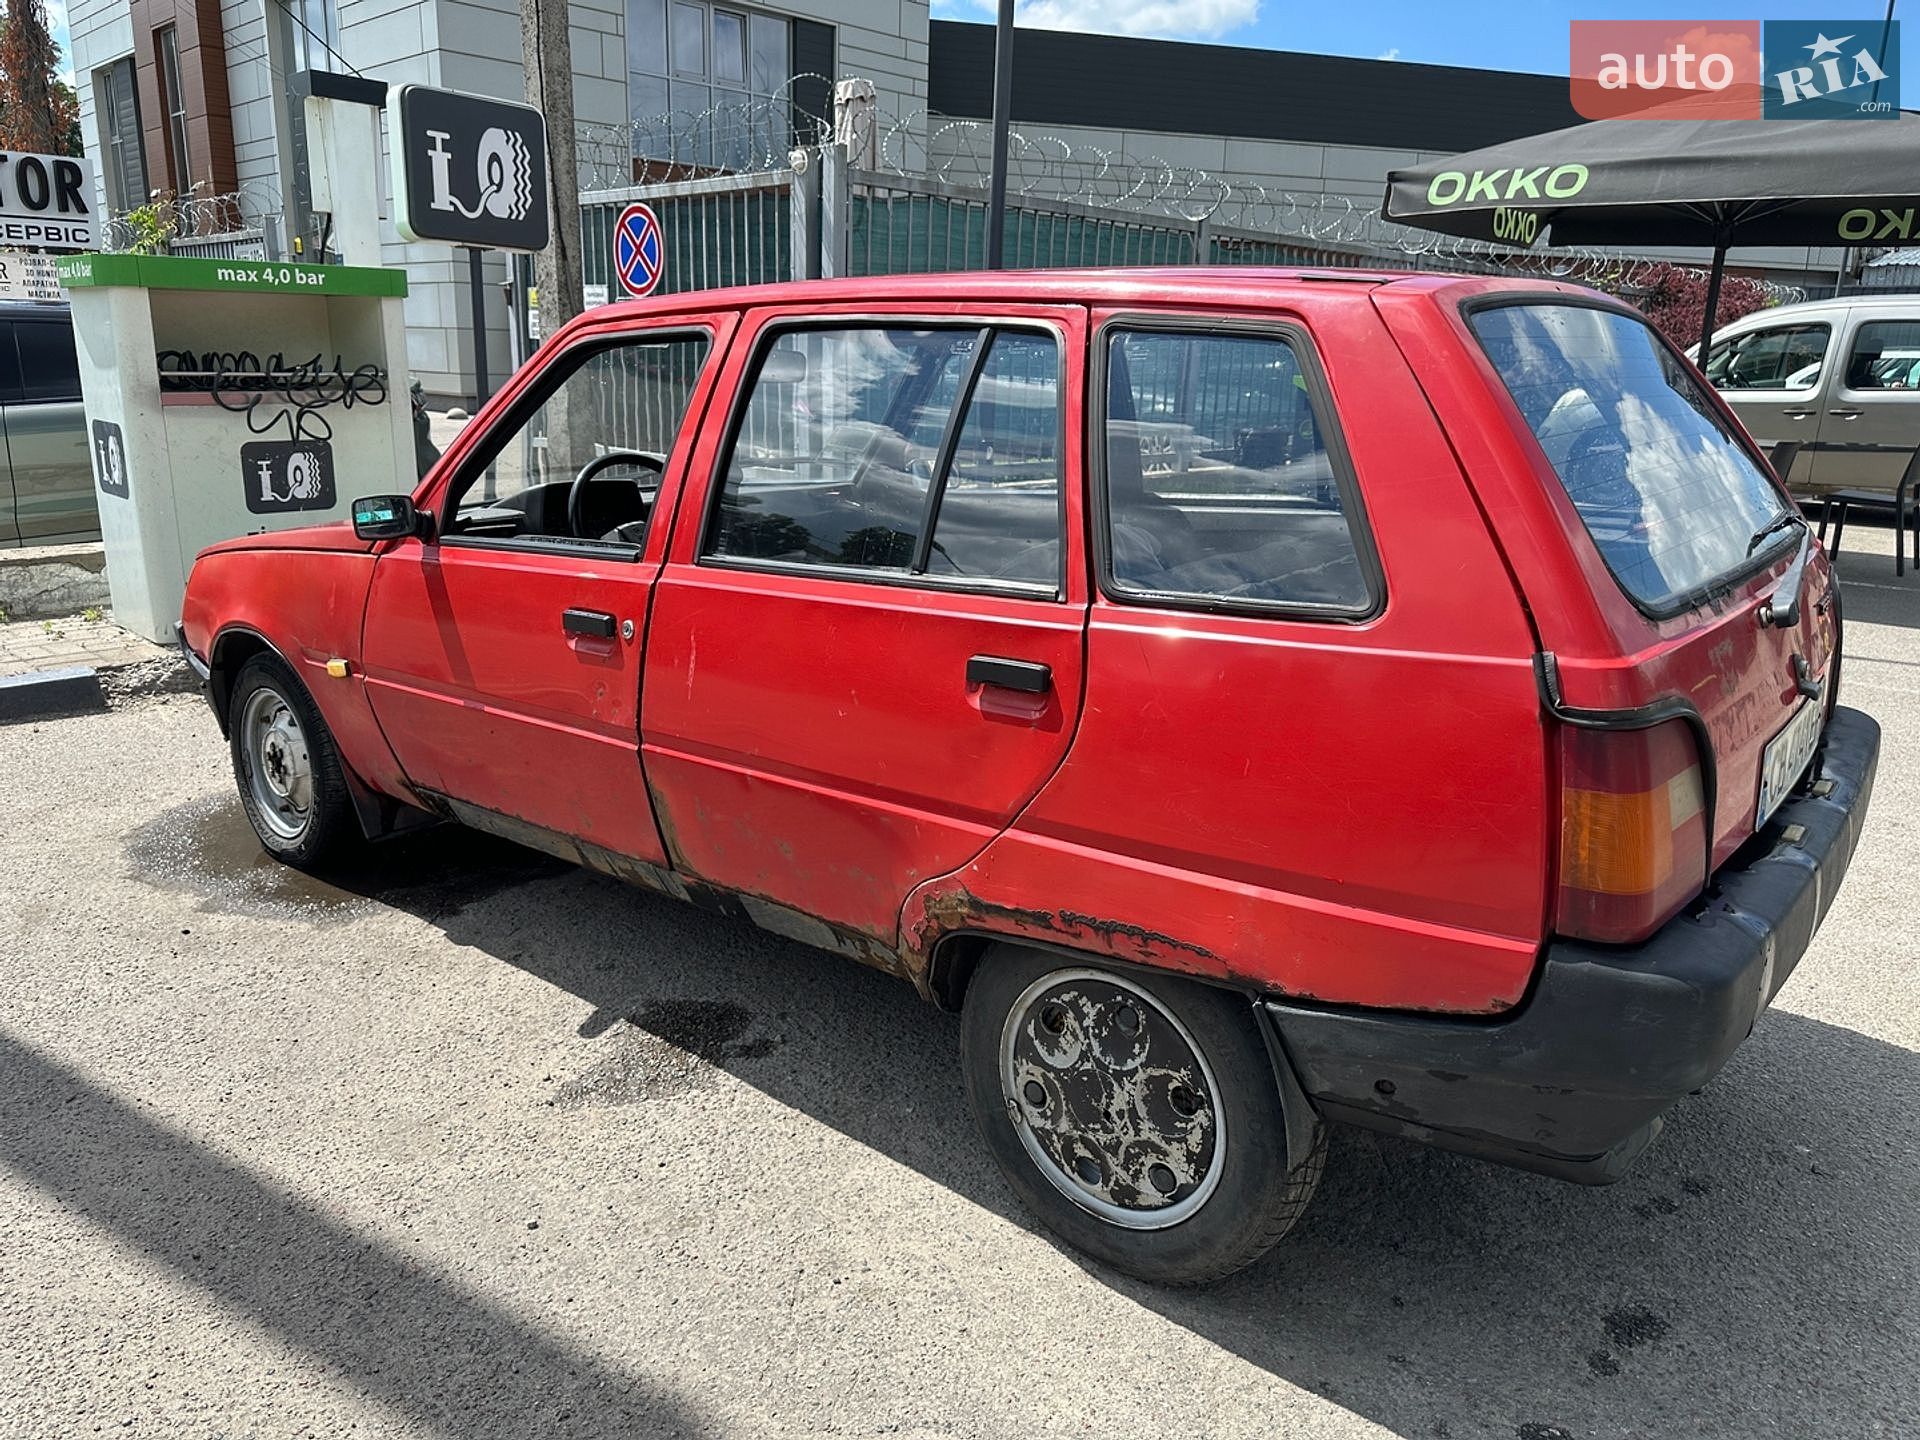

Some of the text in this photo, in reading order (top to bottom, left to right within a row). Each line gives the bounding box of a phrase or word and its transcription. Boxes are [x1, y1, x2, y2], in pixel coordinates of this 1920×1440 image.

[1427, 163, 1589, 206] OKKO
[217, 268, 325, 286] max 4,0 bar
